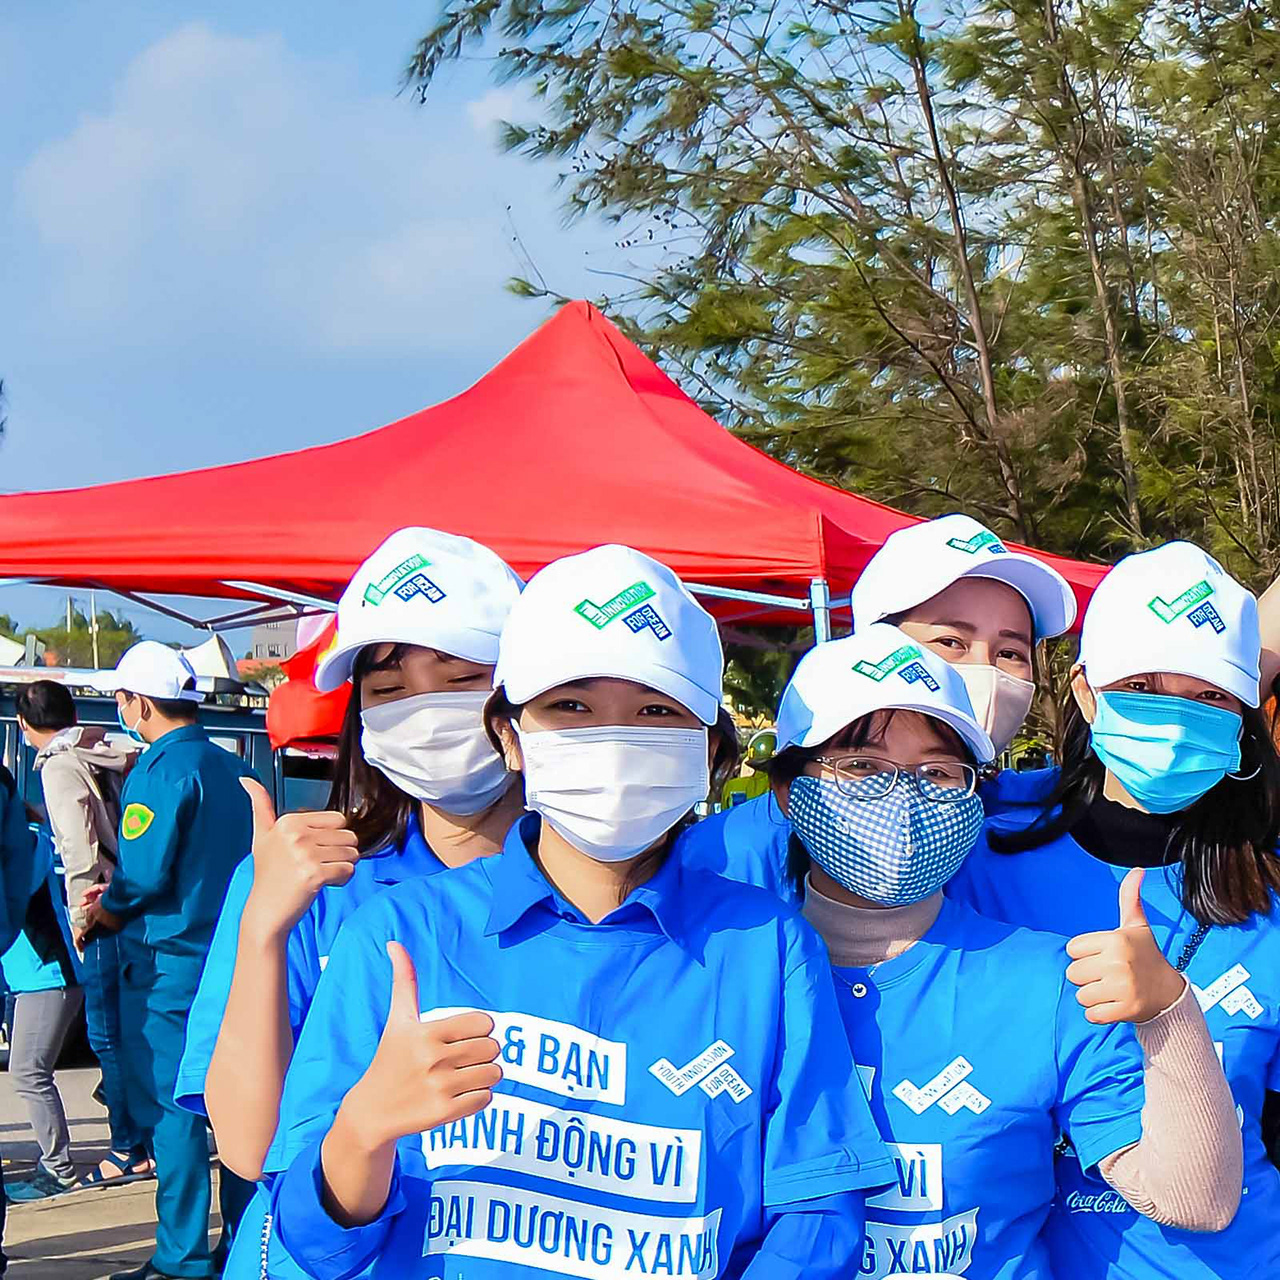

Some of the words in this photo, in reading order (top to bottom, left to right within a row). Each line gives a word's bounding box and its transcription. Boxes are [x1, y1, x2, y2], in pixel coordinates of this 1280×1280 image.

[503, 1025, 526, 1065] &
[537, 1034, 610, 1098] BẠN
[657, 1064, 685, 1090] YOUTH
[705, 1076, 724, 1093] FOR
[719, 1069, 746, 1097] OCEAN
[535, 1118, 635, 1181] ĐỘNG
[650, 1130, 684, 1187] VÌ
[895, 1151, 927, 1198] VÌ
[427, 1193, 475, 1248] ĐẠI
[486, 1198, 613, 1266] DƯƠNG
[626, 1228, 714, 1276] XANH
